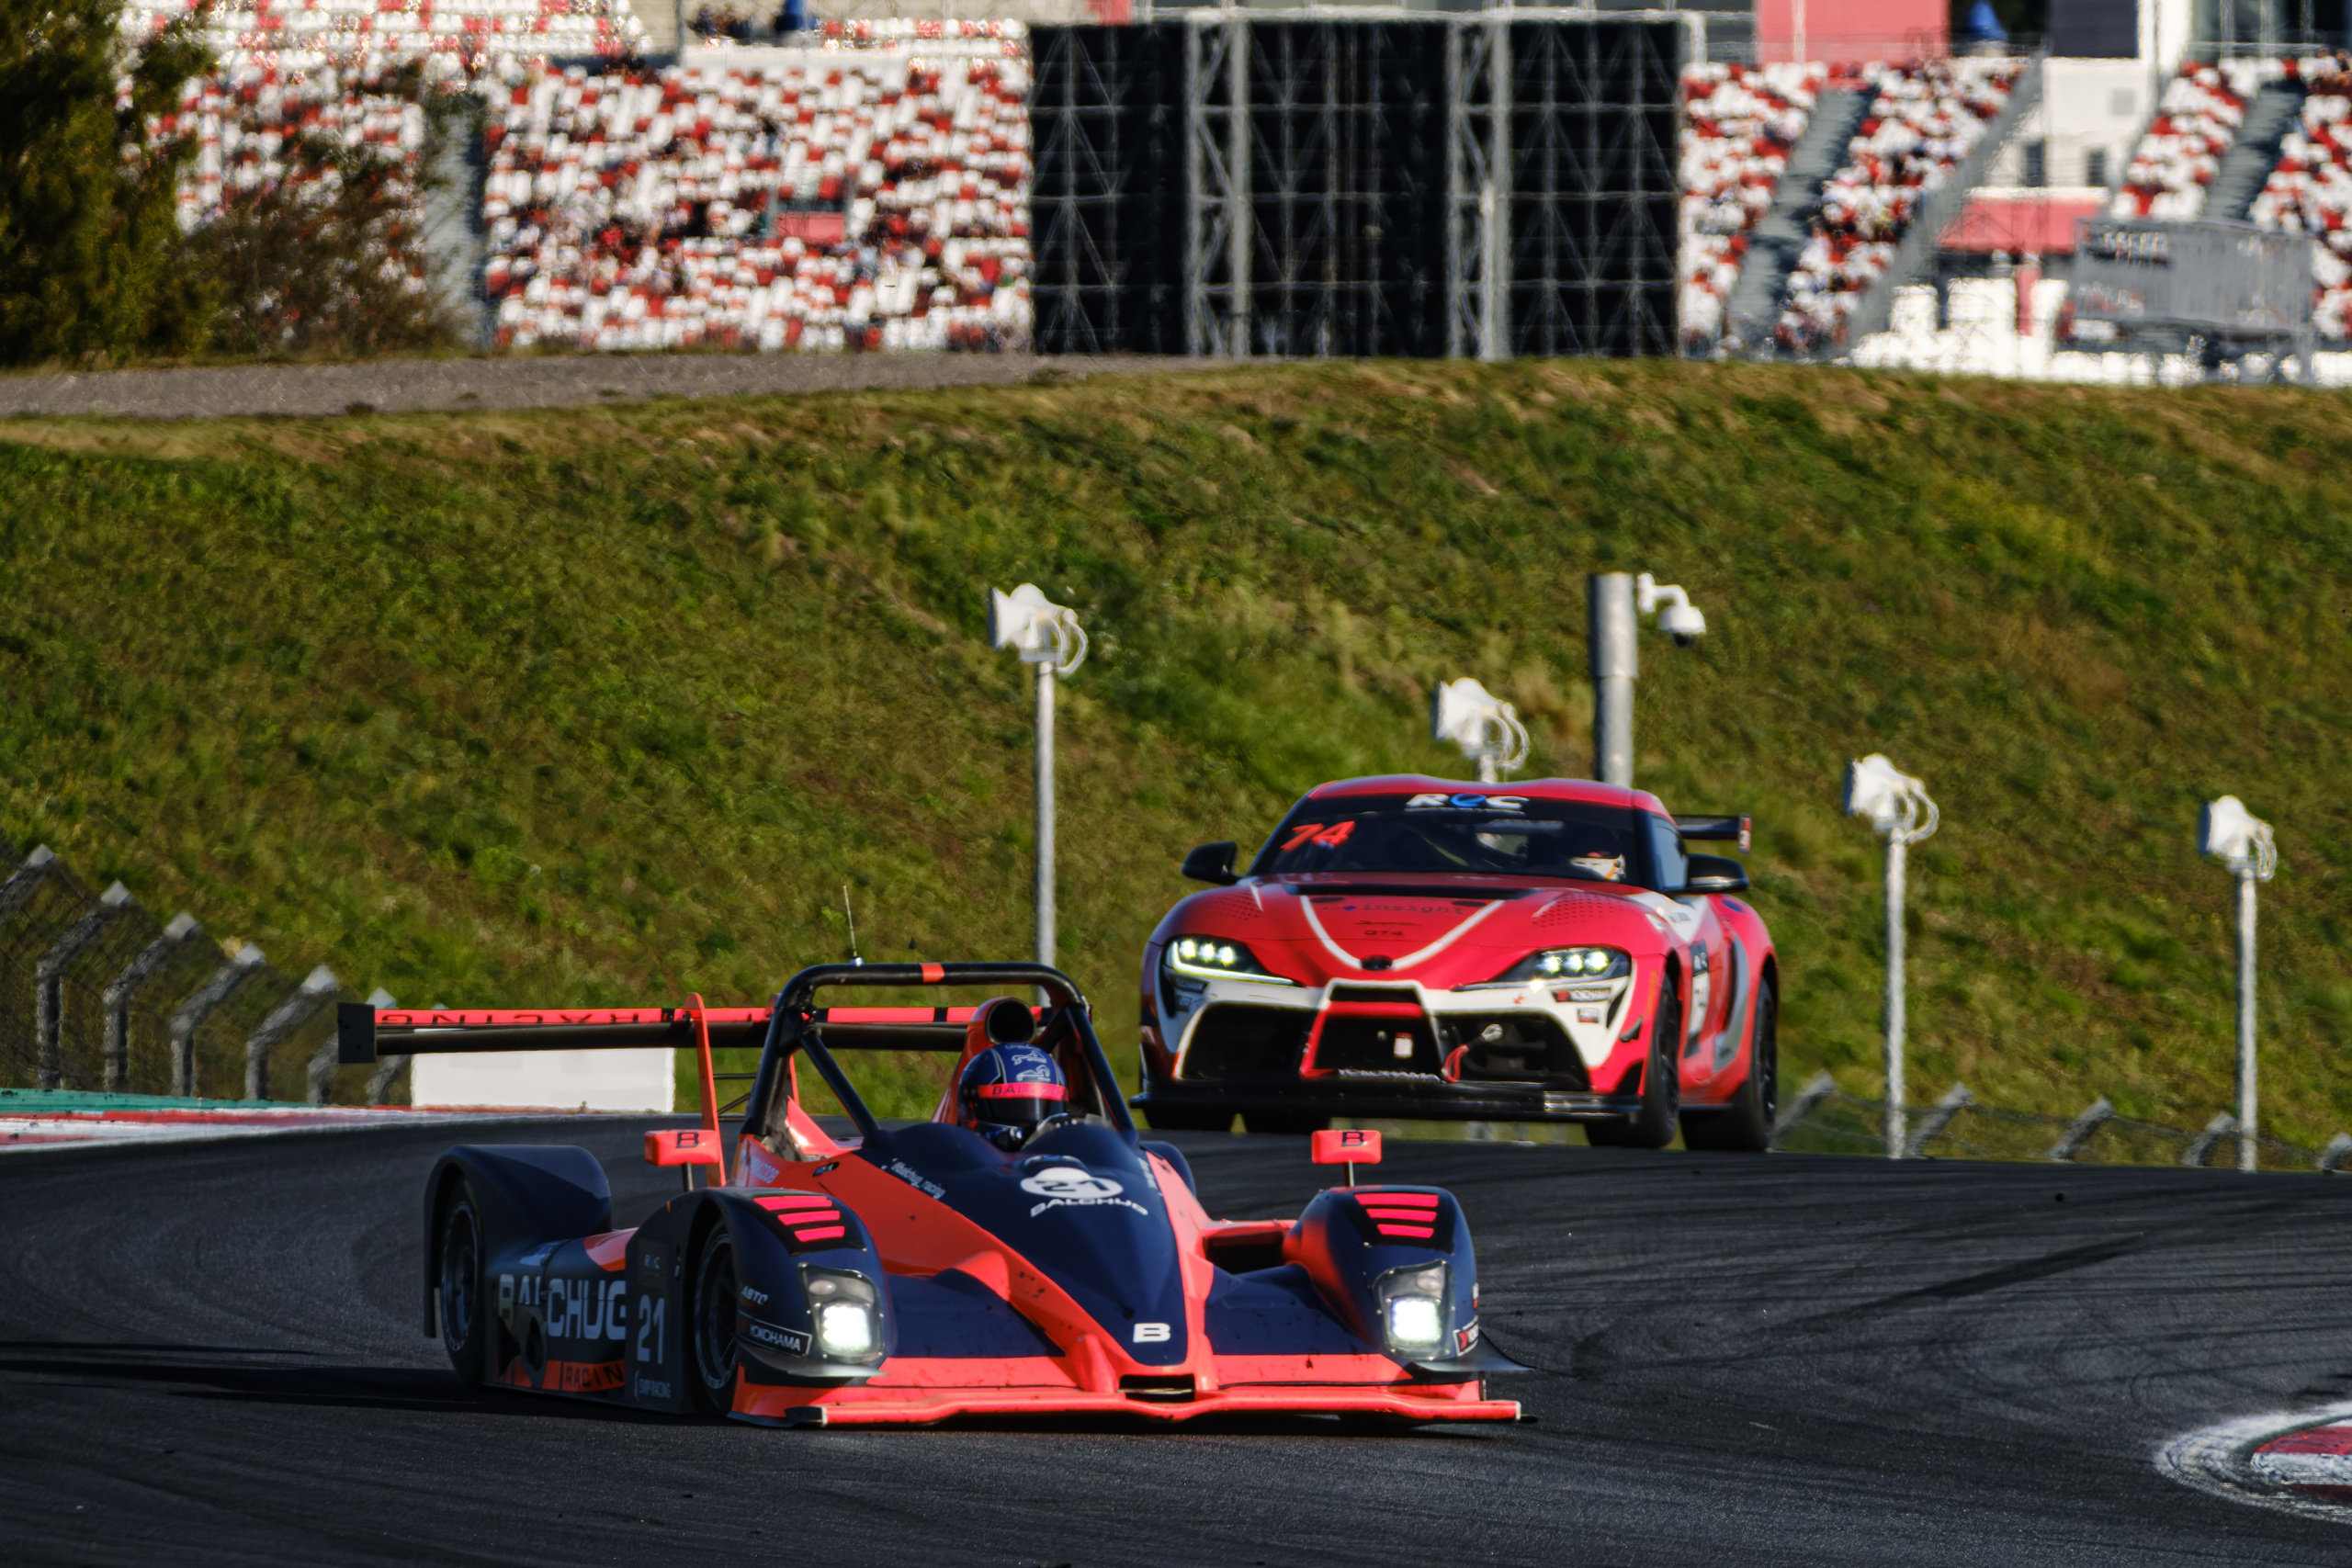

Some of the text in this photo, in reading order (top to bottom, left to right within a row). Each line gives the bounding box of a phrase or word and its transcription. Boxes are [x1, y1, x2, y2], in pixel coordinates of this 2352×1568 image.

[1281, 820, 1356, 852] 74
[675, 1131, 700, 1149] B
[1341, 1131, 1364, 1147] B
[1035, 1179, 1111, 1192] 21
[636, 1293, 665, 1365] 21
[749, 1324, 801, 1352] YOKOHAMA
[1132, 1322, 1171, 1343] B
